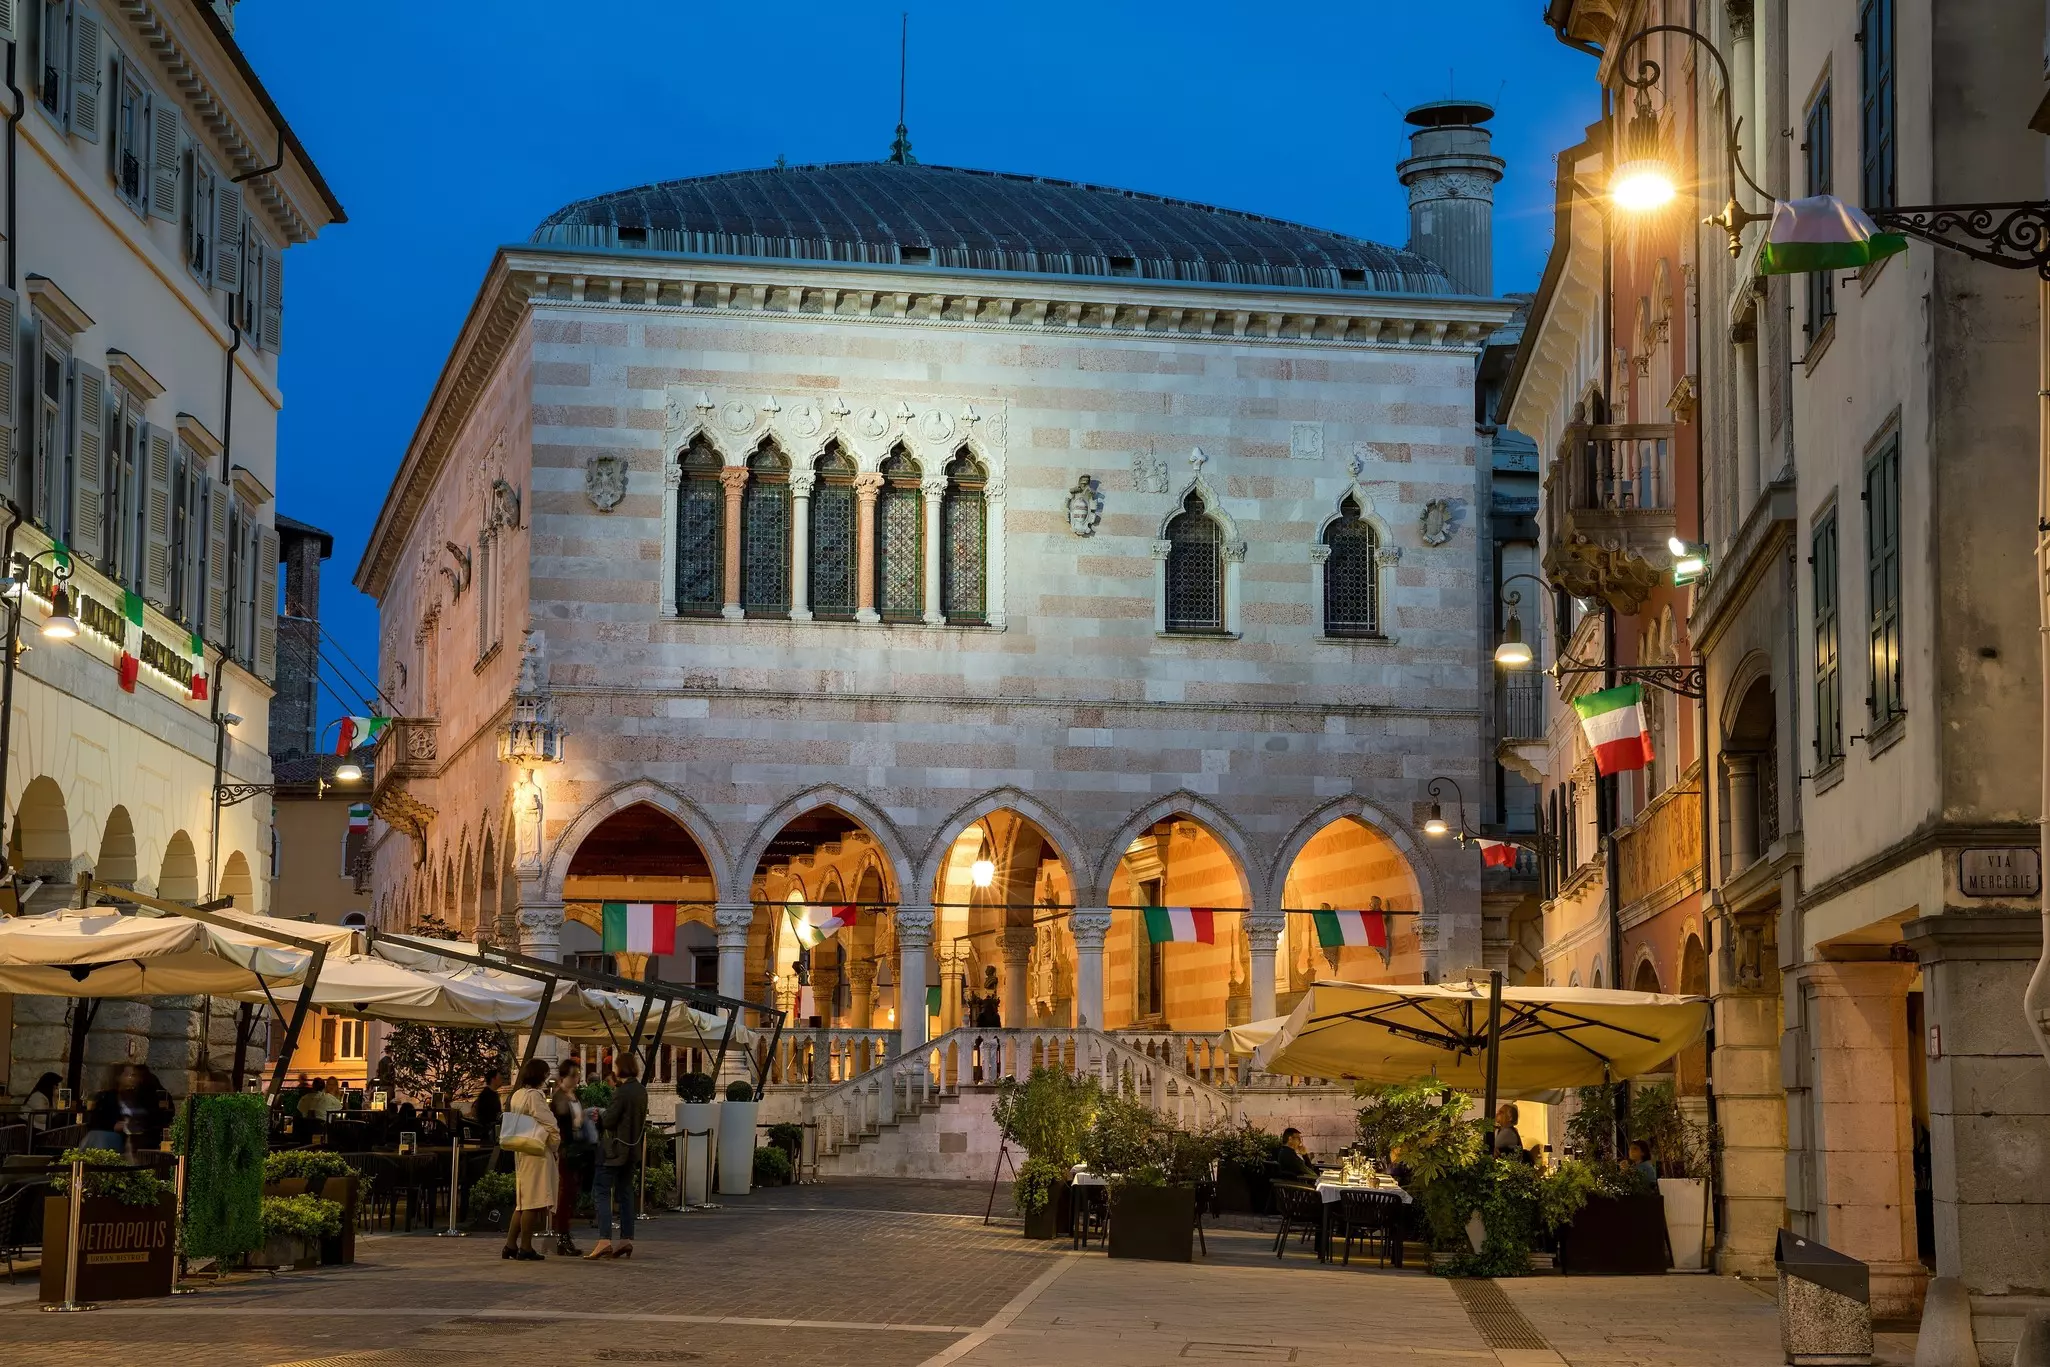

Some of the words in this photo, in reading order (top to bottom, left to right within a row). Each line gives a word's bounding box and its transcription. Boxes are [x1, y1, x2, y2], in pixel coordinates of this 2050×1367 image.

[1987, 855, 2012, 868] VIA
[1969, 874, 2032, 890] MERCERIE
[79, 1220, 167, 1250] METROPOLIS
